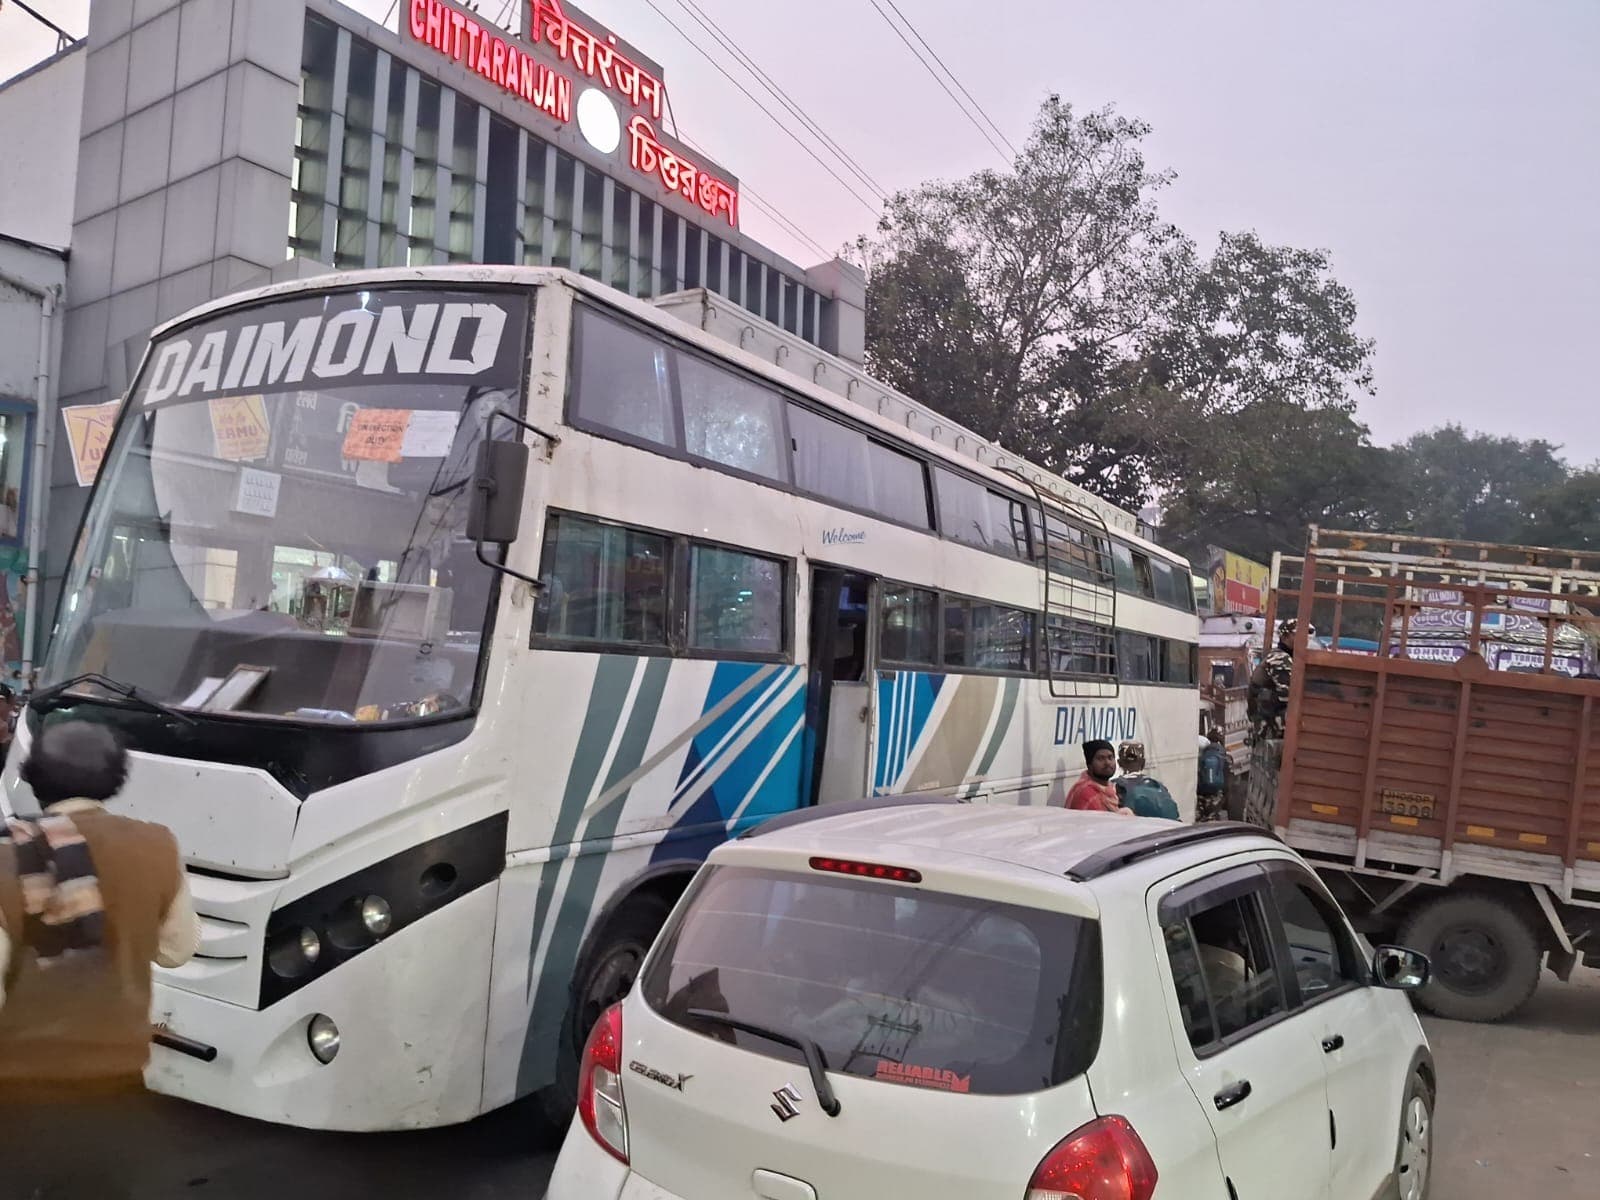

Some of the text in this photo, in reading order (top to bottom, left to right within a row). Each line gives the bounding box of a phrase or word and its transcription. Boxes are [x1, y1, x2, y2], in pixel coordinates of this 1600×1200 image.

[410, 0, 571, 122] CHITTARANJAN
[143, 303, 508, 406] DAIMOND
[822, 527, 865, 544] Welcome
[1055, 706, 1136, 745] DIAMOND
